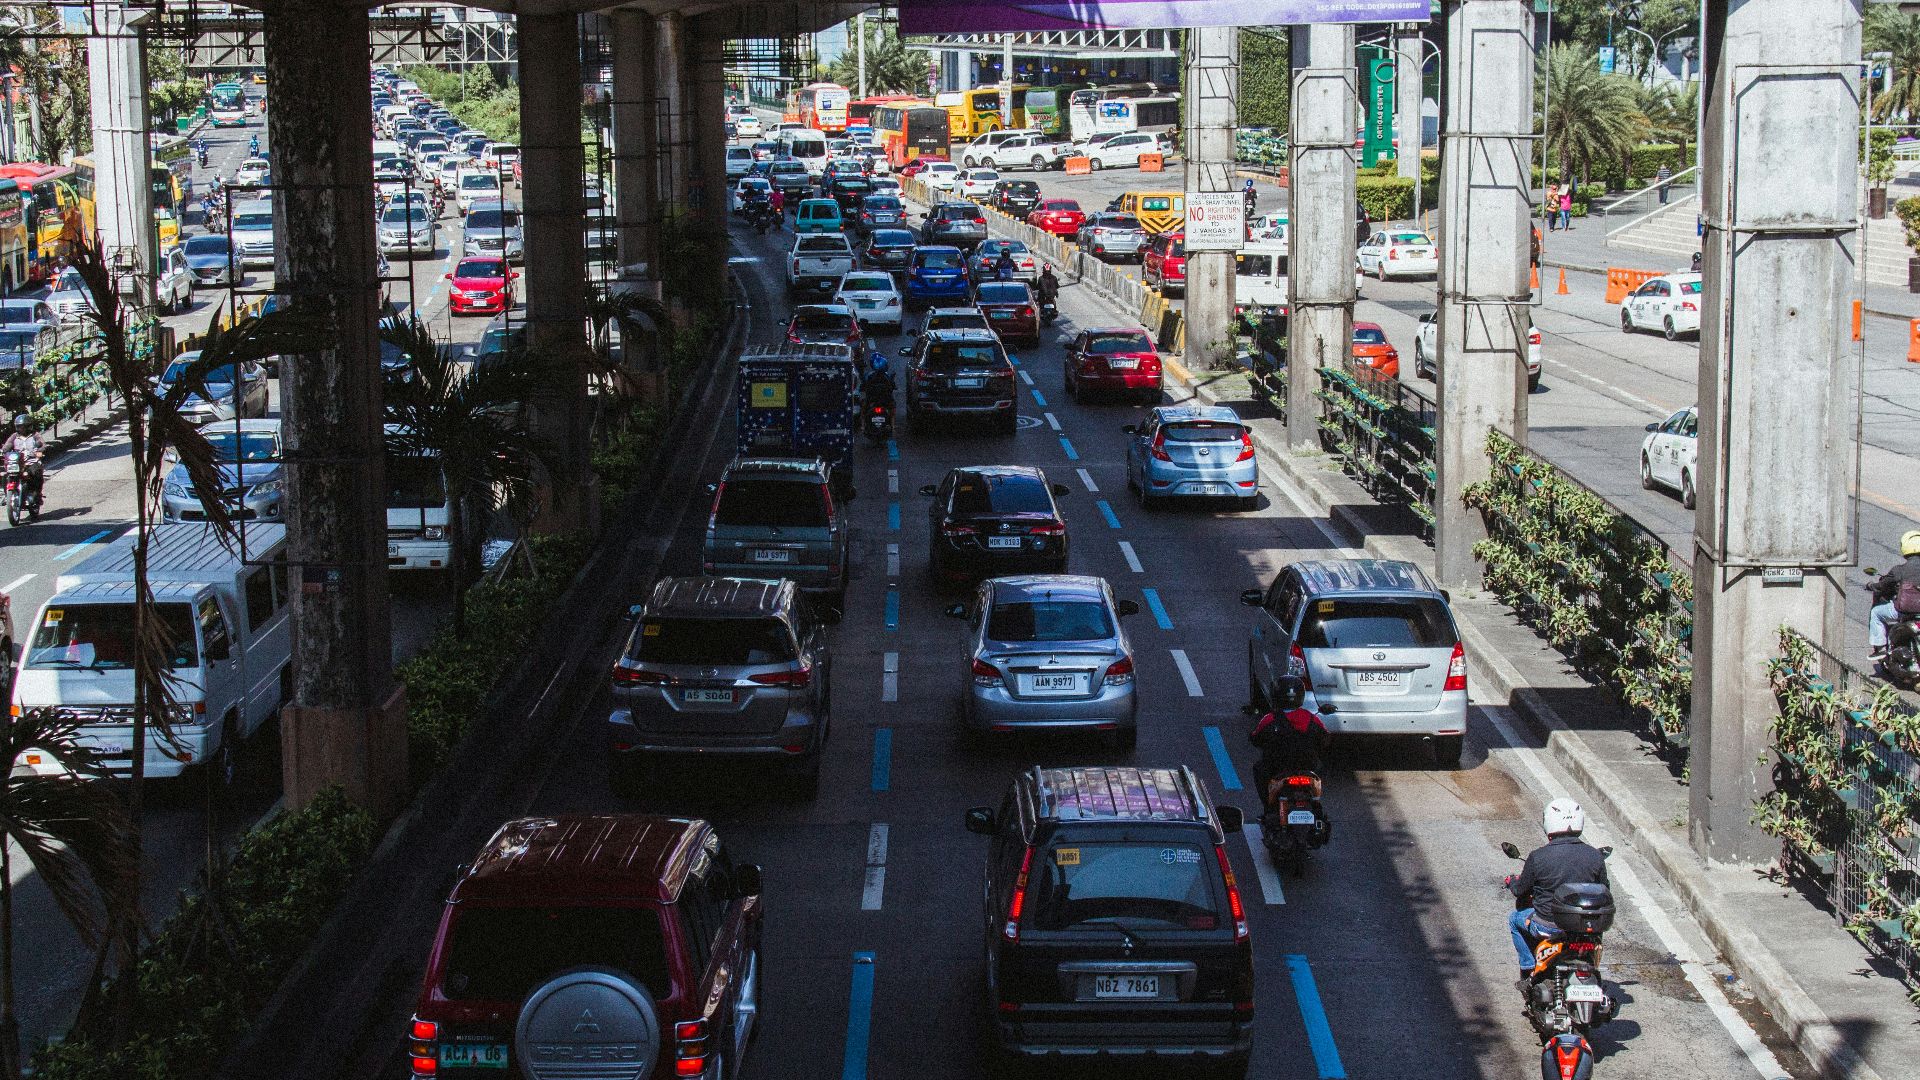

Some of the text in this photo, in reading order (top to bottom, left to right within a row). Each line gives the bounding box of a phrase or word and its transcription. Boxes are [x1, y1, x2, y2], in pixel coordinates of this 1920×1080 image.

[1189, 206, 1204, 221] NO
[1053, 677, 1073, 687] 9977
[1359, 673, 1375, 682] ABS
[1097, 980, 1157, 993] NBZ 7861
